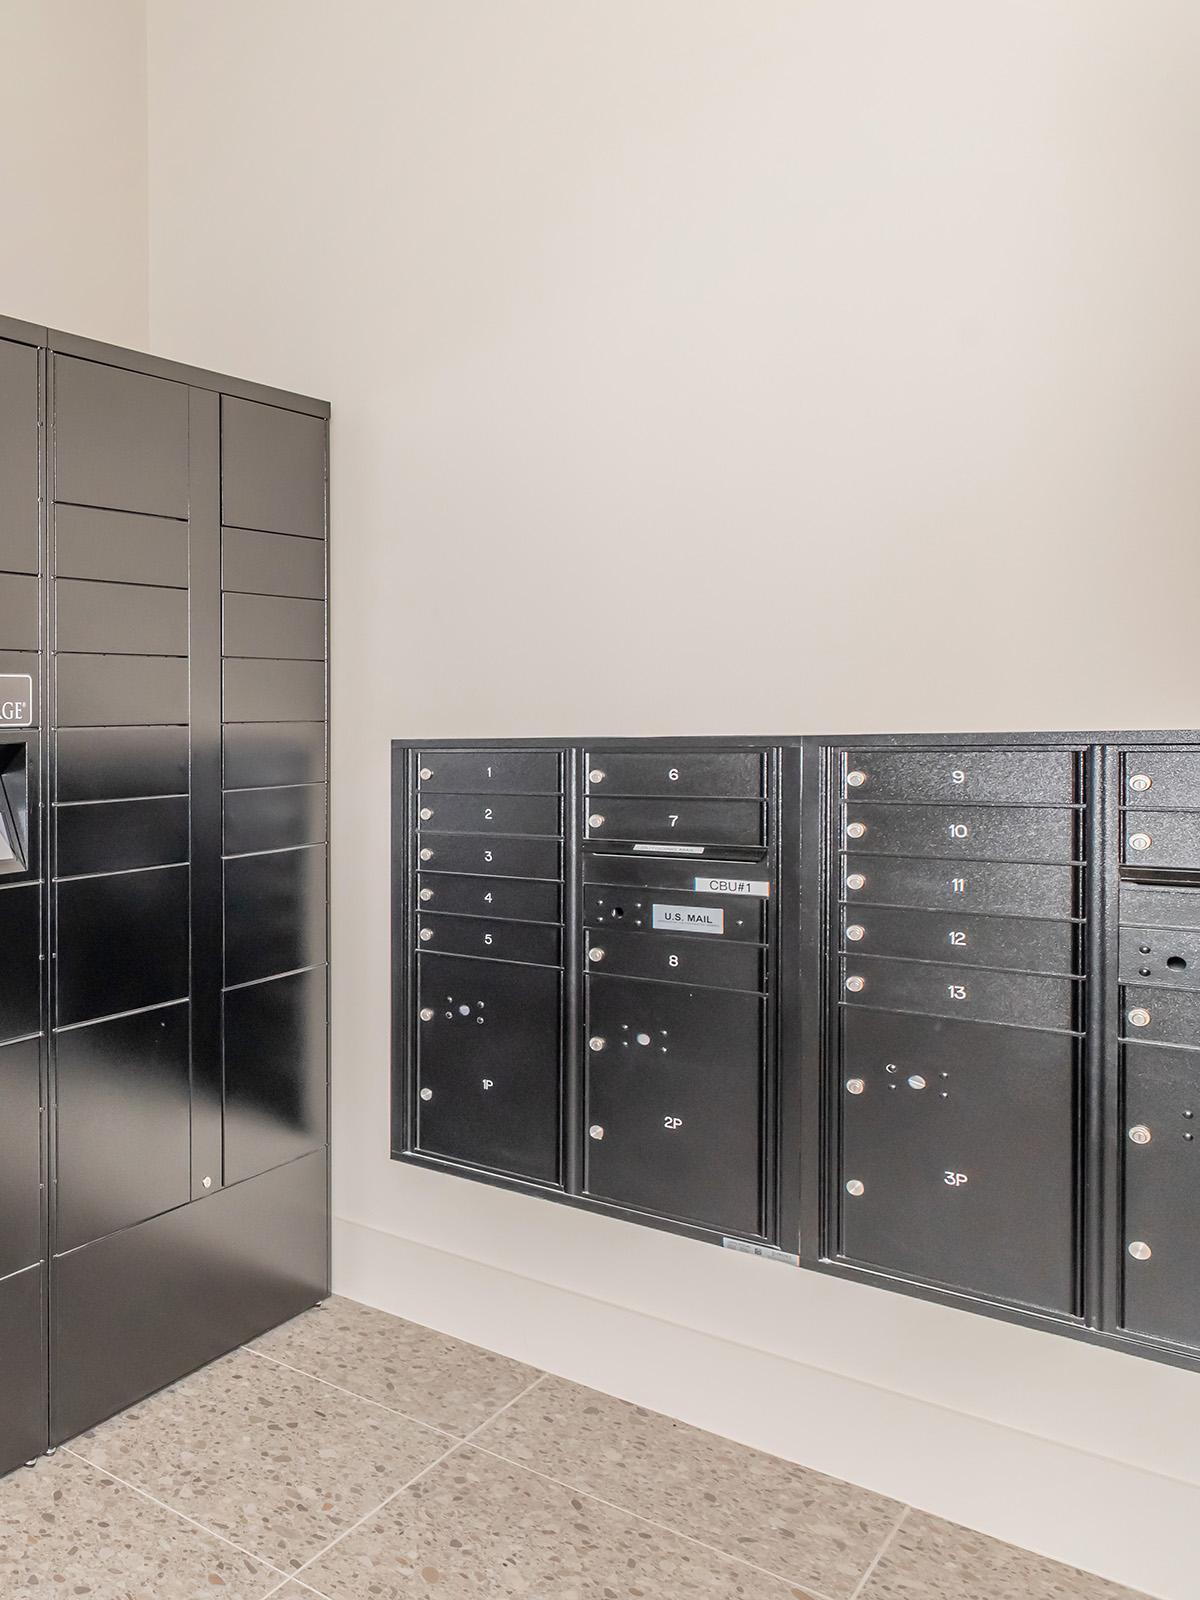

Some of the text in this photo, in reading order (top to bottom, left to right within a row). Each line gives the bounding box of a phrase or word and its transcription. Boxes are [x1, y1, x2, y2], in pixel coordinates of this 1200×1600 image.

[486, 766, 493, 778] 1
[668, 768, 679, 781] 6
[951, 770, 965, 784] 9
[484, 808, 493, 820] 2
[668, 814, 679, 827] 7
[948, 824, 969, 838] 10
[484, 850, 493, 862] 3
[709, 880, 752, 893] CBU#1
[951, 878, 965, 892] 11
[484, 892, 493, 904] 4
[664, 912, 684, 922] U.S.
[687, 914, 713, 924] MAIL
[484, 933, 493, 945] 5
[948, 931, 967, 946] 12
[668, 954, 679, 967] 8
[947, 985, 967, 1000] 13
[482, 1078, 494, 1090] 1P
[664, 1116, 683, 1130] 2P
[943, 1170, 968, 1187] 3P
